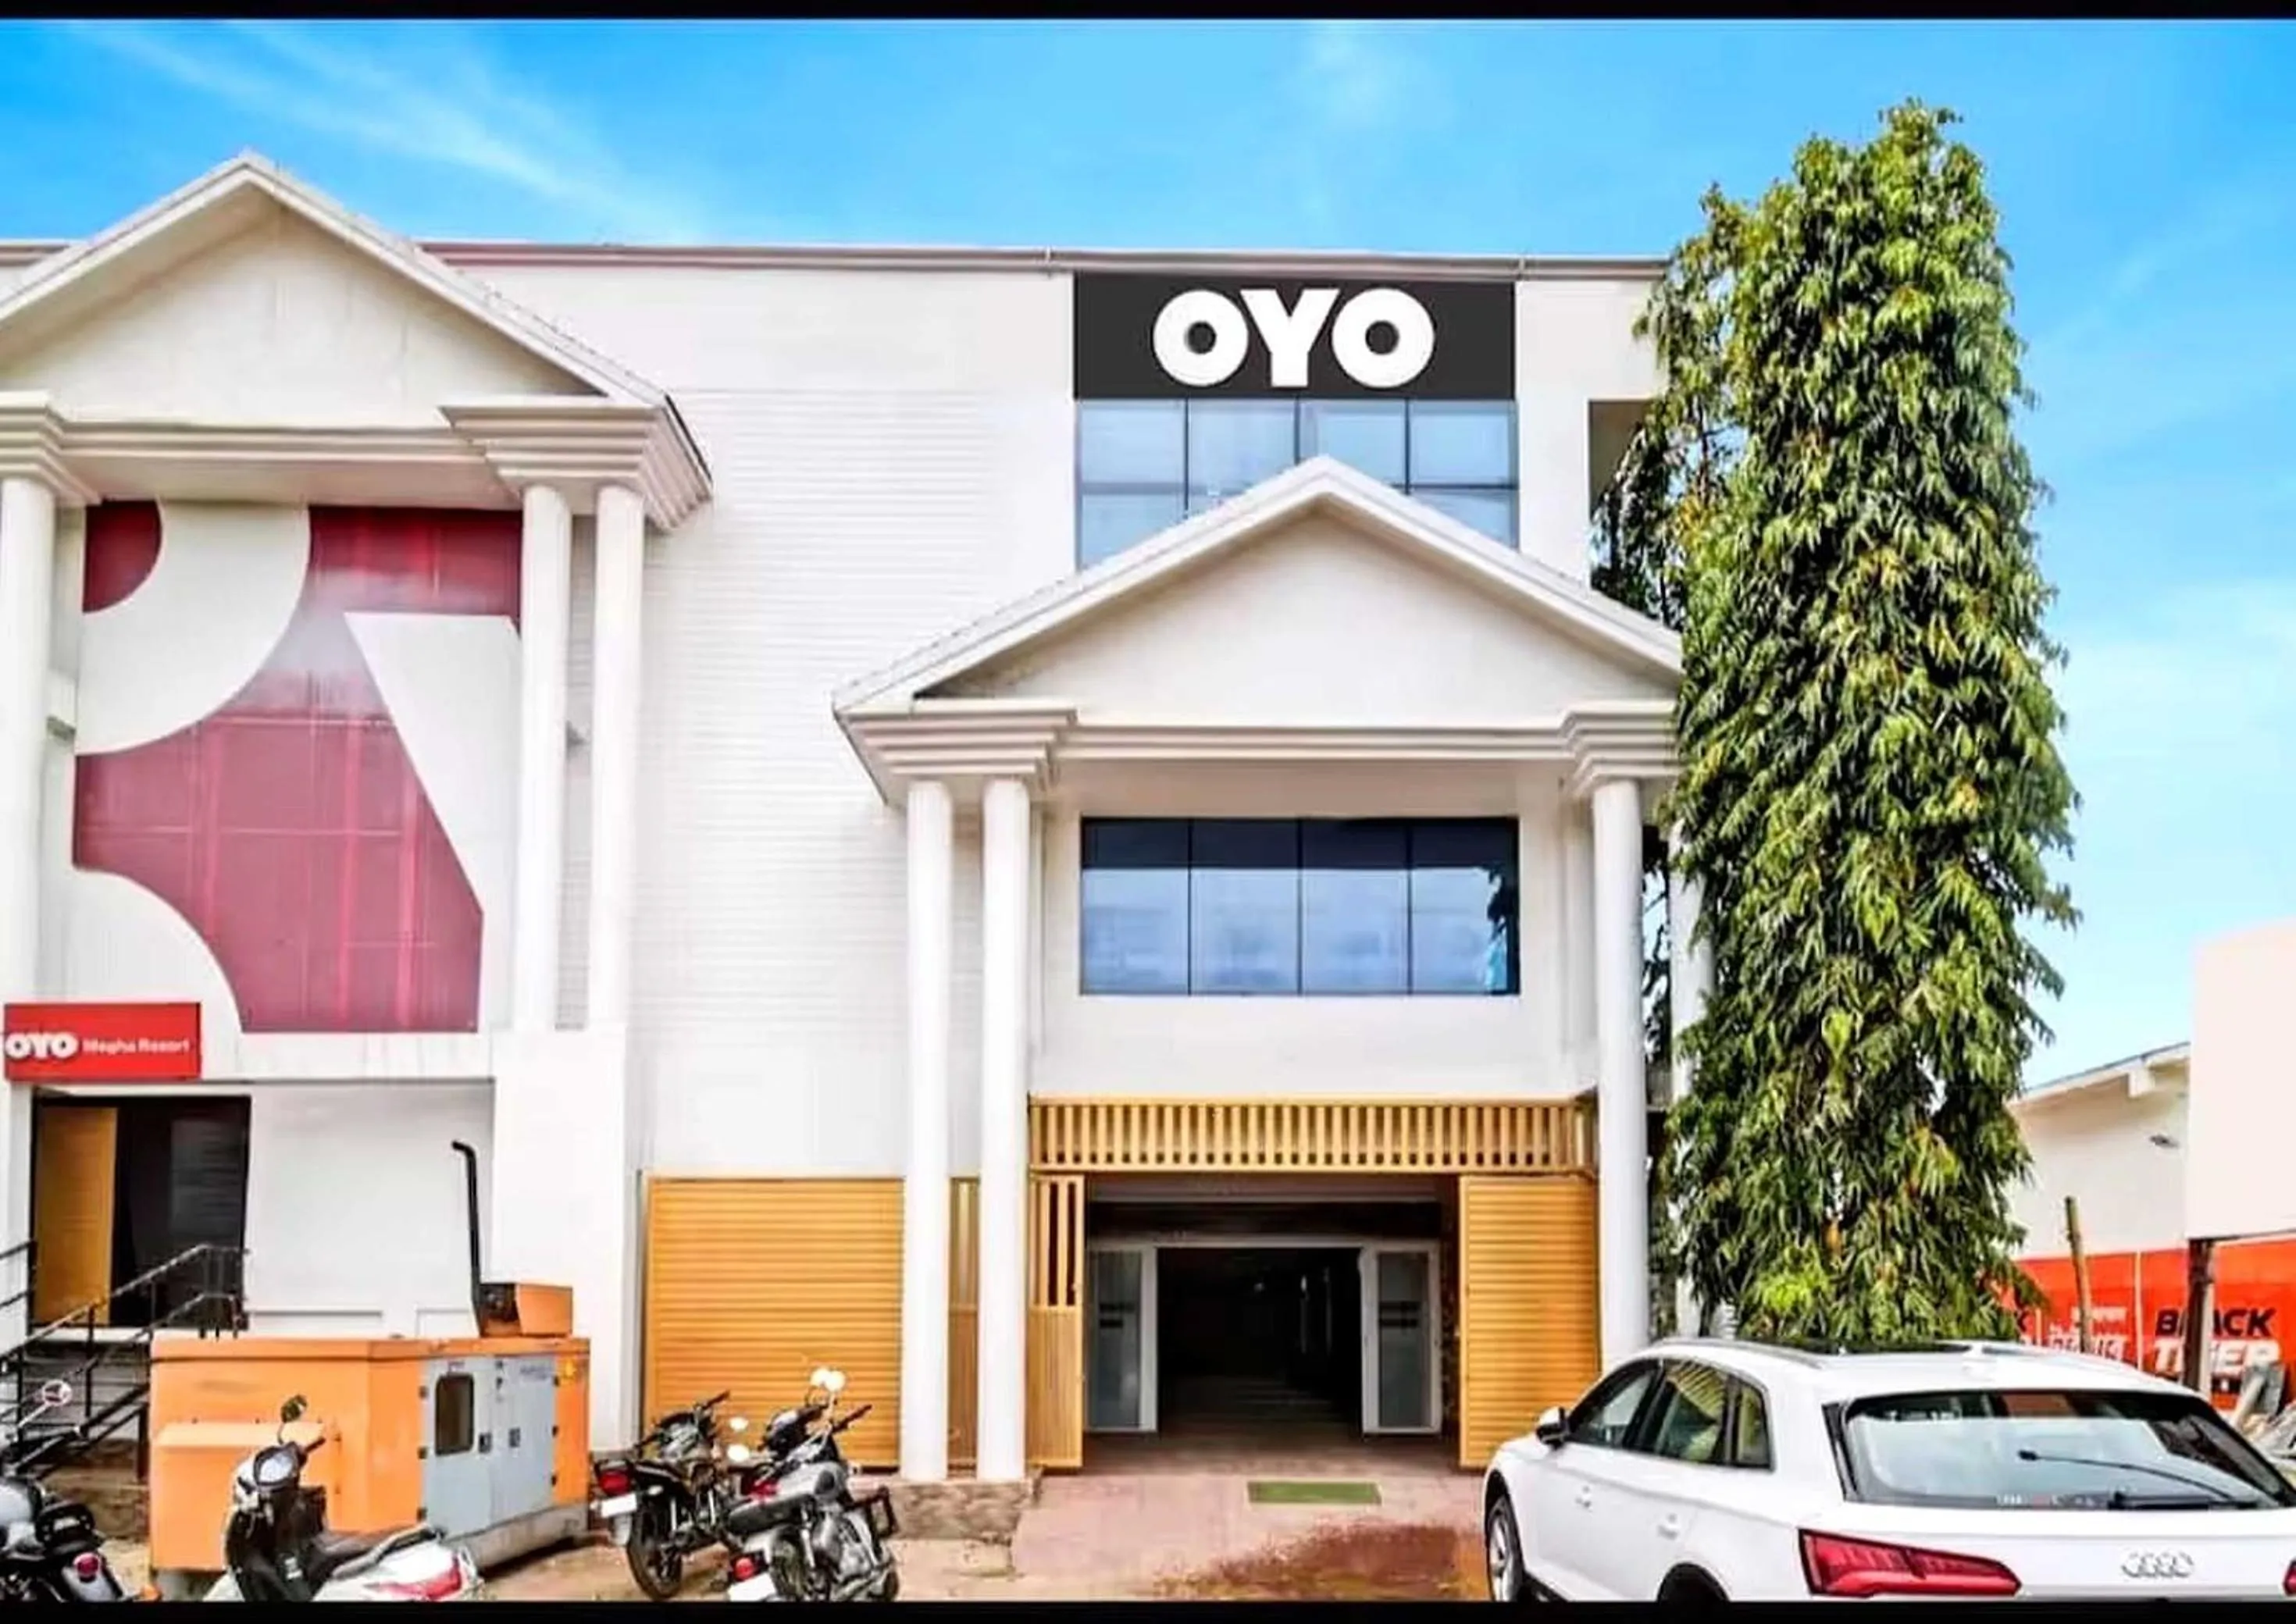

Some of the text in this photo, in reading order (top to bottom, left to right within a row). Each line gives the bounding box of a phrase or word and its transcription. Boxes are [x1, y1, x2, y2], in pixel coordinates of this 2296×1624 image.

[1153, 287, 1435, 389] OYO
[5, 1032, 77, 1059] OYO
[2155, 1308, 2276, 1337] BCK
[2153, 1338, 2281, 1375] TIER
